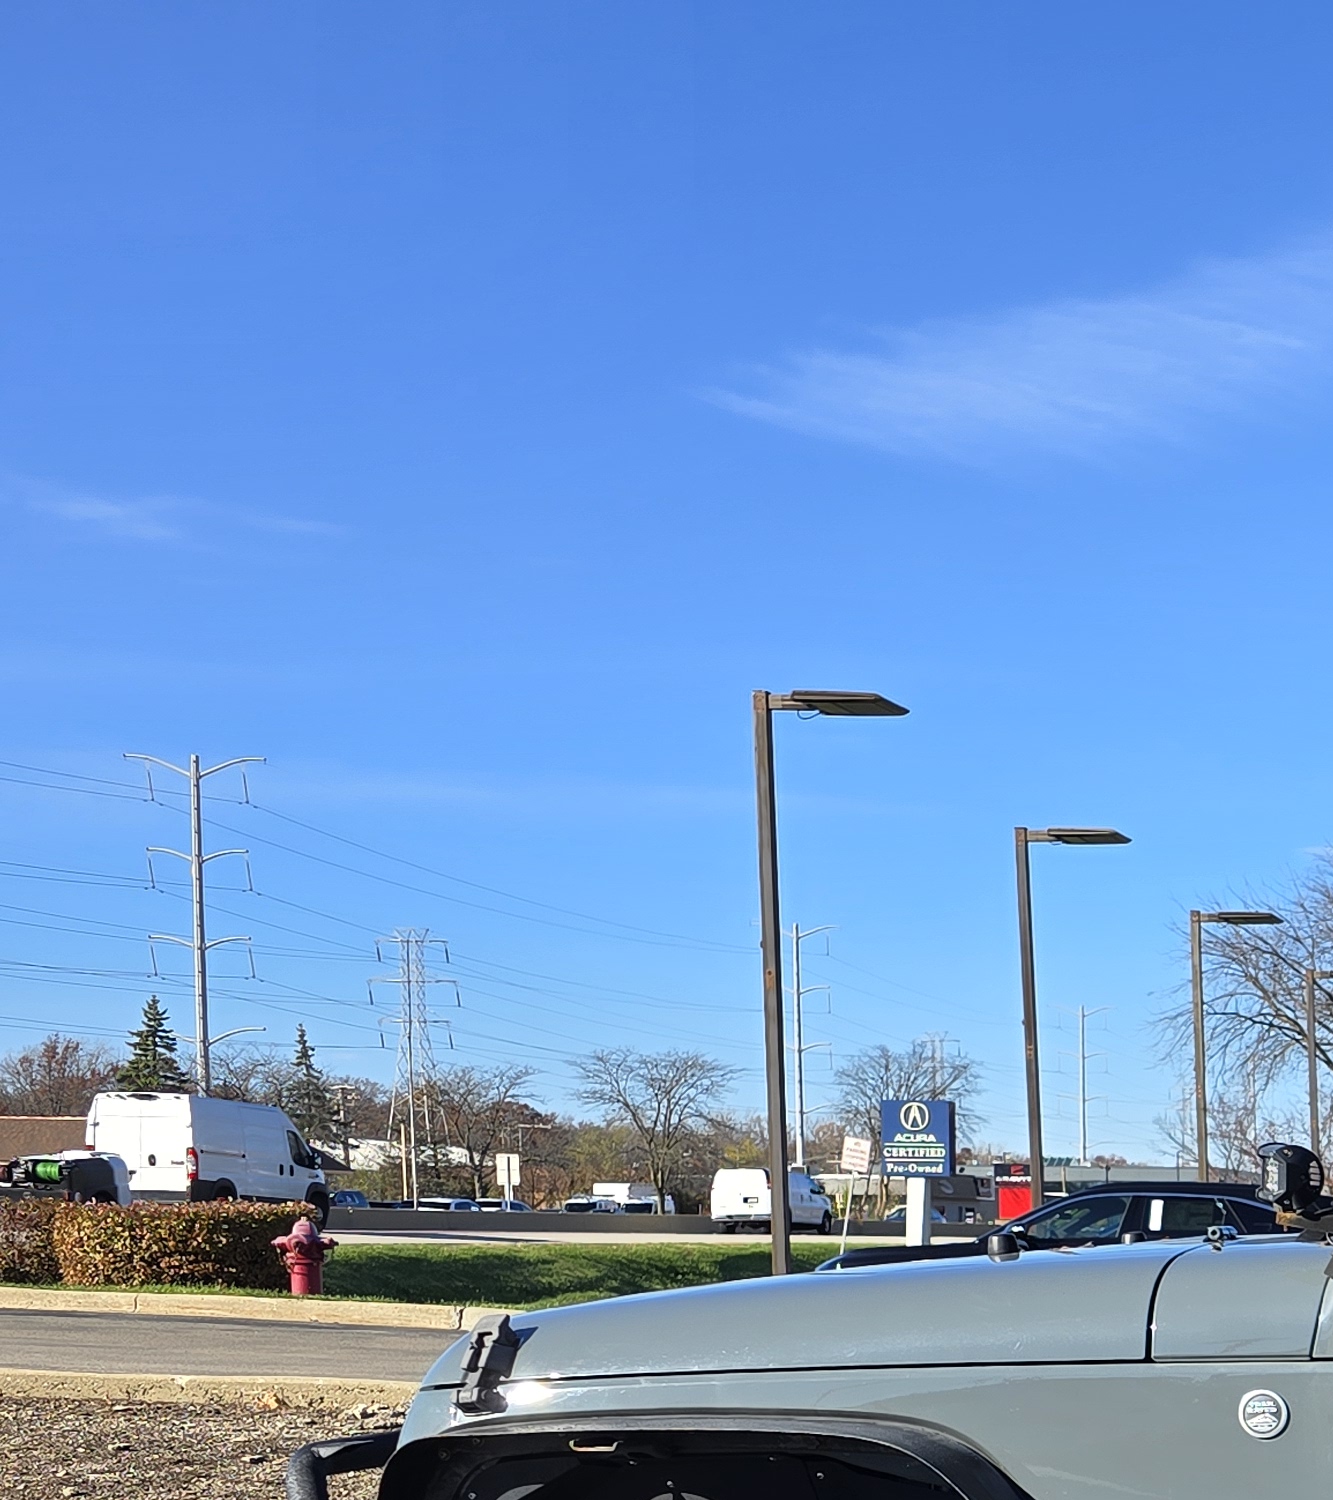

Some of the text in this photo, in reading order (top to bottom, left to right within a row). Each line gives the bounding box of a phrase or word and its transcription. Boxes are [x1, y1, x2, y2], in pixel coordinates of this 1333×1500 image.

[894, 1133, 937, 1143] ACURA
[883, 1147, 946, 1158] CERTIFIED
[886, 1163, 944, 1174] Pre-Owned
